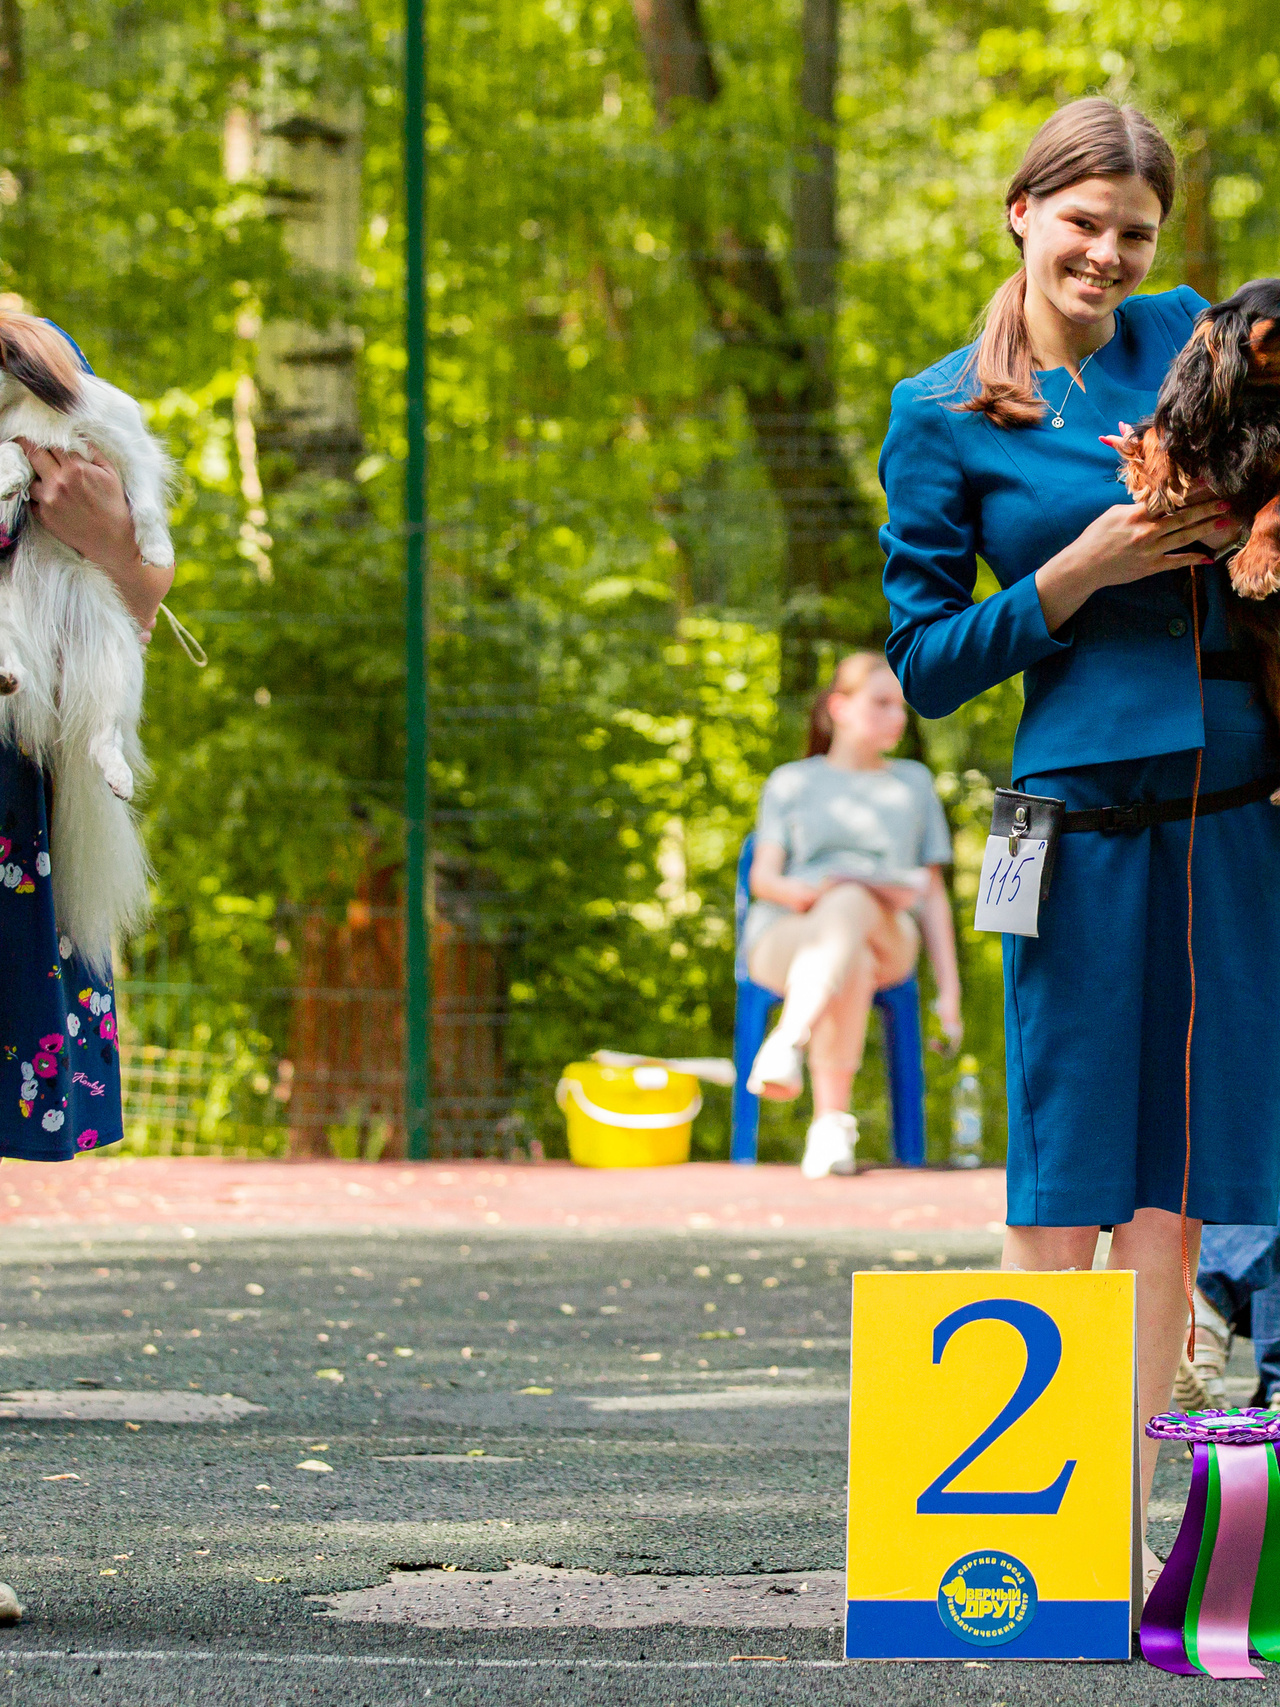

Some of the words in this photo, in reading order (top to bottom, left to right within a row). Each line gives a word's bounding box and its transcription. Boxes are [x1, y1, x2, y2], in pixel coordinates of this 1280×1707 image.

[986, 857, 1035, 905] 115
[916, 1298, 1077, 1515] 2
[957, 1557, 997, 1576] СЕРГИЕВ
[1000, 1559, 1026, 1584] ПОСАД
[960, 1600, 1021, 1618] ДРУГ
[966, 1586, 1021, 1600] ВЕРНЫЙ
[947, 1597, 1016, 1638] КИНОЛОГИЧЕСКИЙ
[1015, 1592, 1029, 1622] ЦЕНТР
